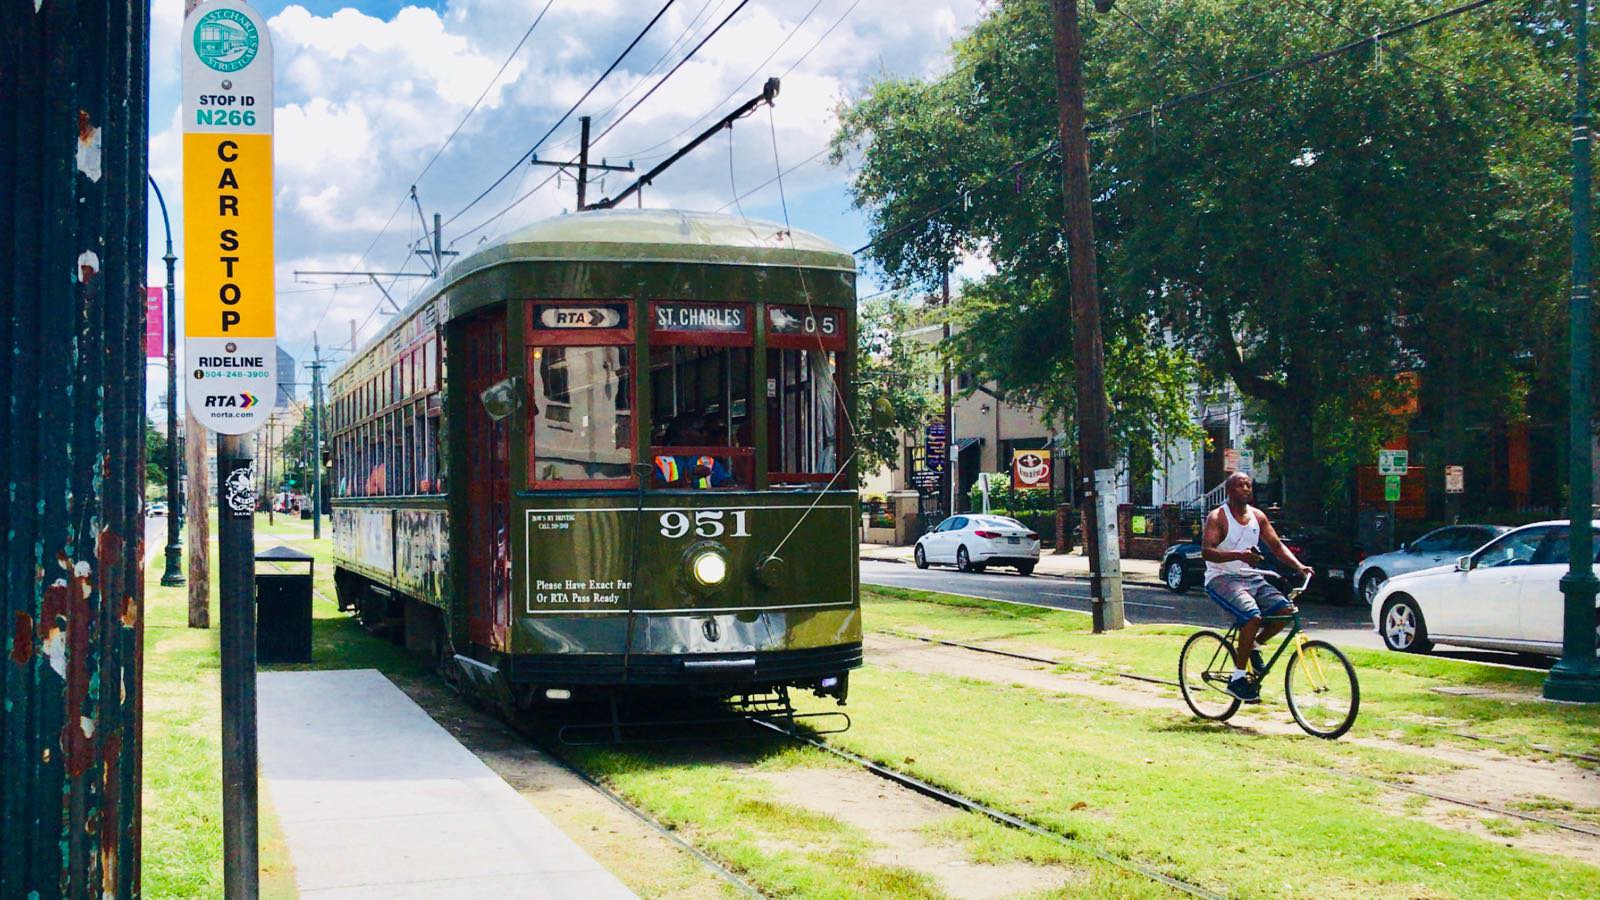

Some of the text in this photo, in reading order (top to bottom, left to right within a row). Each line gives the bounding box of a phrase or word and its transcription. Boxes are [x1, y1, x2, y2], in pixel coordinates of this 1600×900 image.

[223, 10, 258, 48] CHARLES
[200, 95, 255, 106] STOP ID
[197, 109, 256, 126] N266
[217, 140, 242, 332] CAR STOP
[557, 312, 585, 324] RTA
[658, 308, 741, 326] ST. CHARLES
[199, 356, 264, 368] RIDELINE
[205, 395, 236, 407] RTA
[660, 510, 752, 538] 951
[536, 580, 562, 590] Please
[565, 580, 586, 590] Have
[589, 579, 614, 590] Exact
[536, 592, 619, 604] Or RTA Pass Ready
